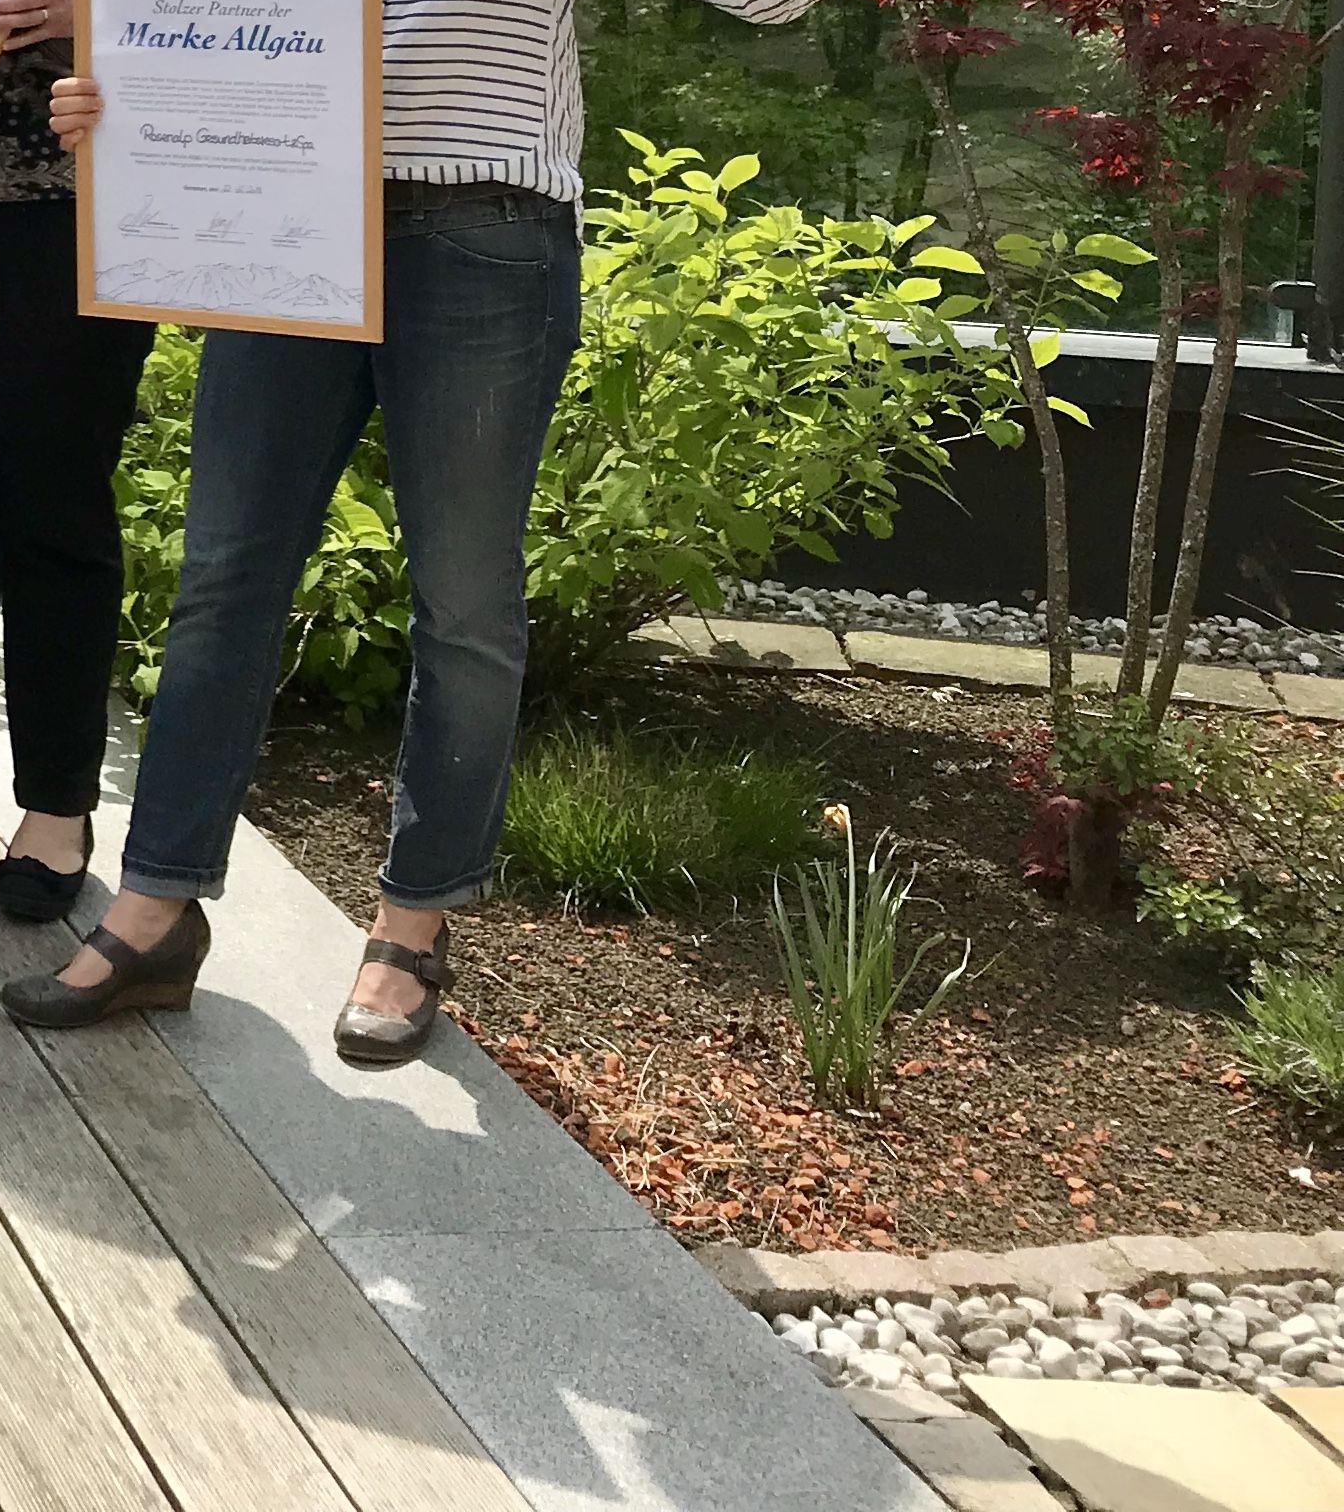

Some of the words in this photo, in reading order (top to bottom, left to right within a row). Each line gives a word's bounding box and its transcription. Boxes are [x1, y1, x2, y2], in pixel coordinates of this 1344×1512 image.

[207, 0, 267, 19] Partner
[268, 2, 293, 19] der
[117, 22, 217, 50] Marke
[222, 24, 326, 60] Allgäu
